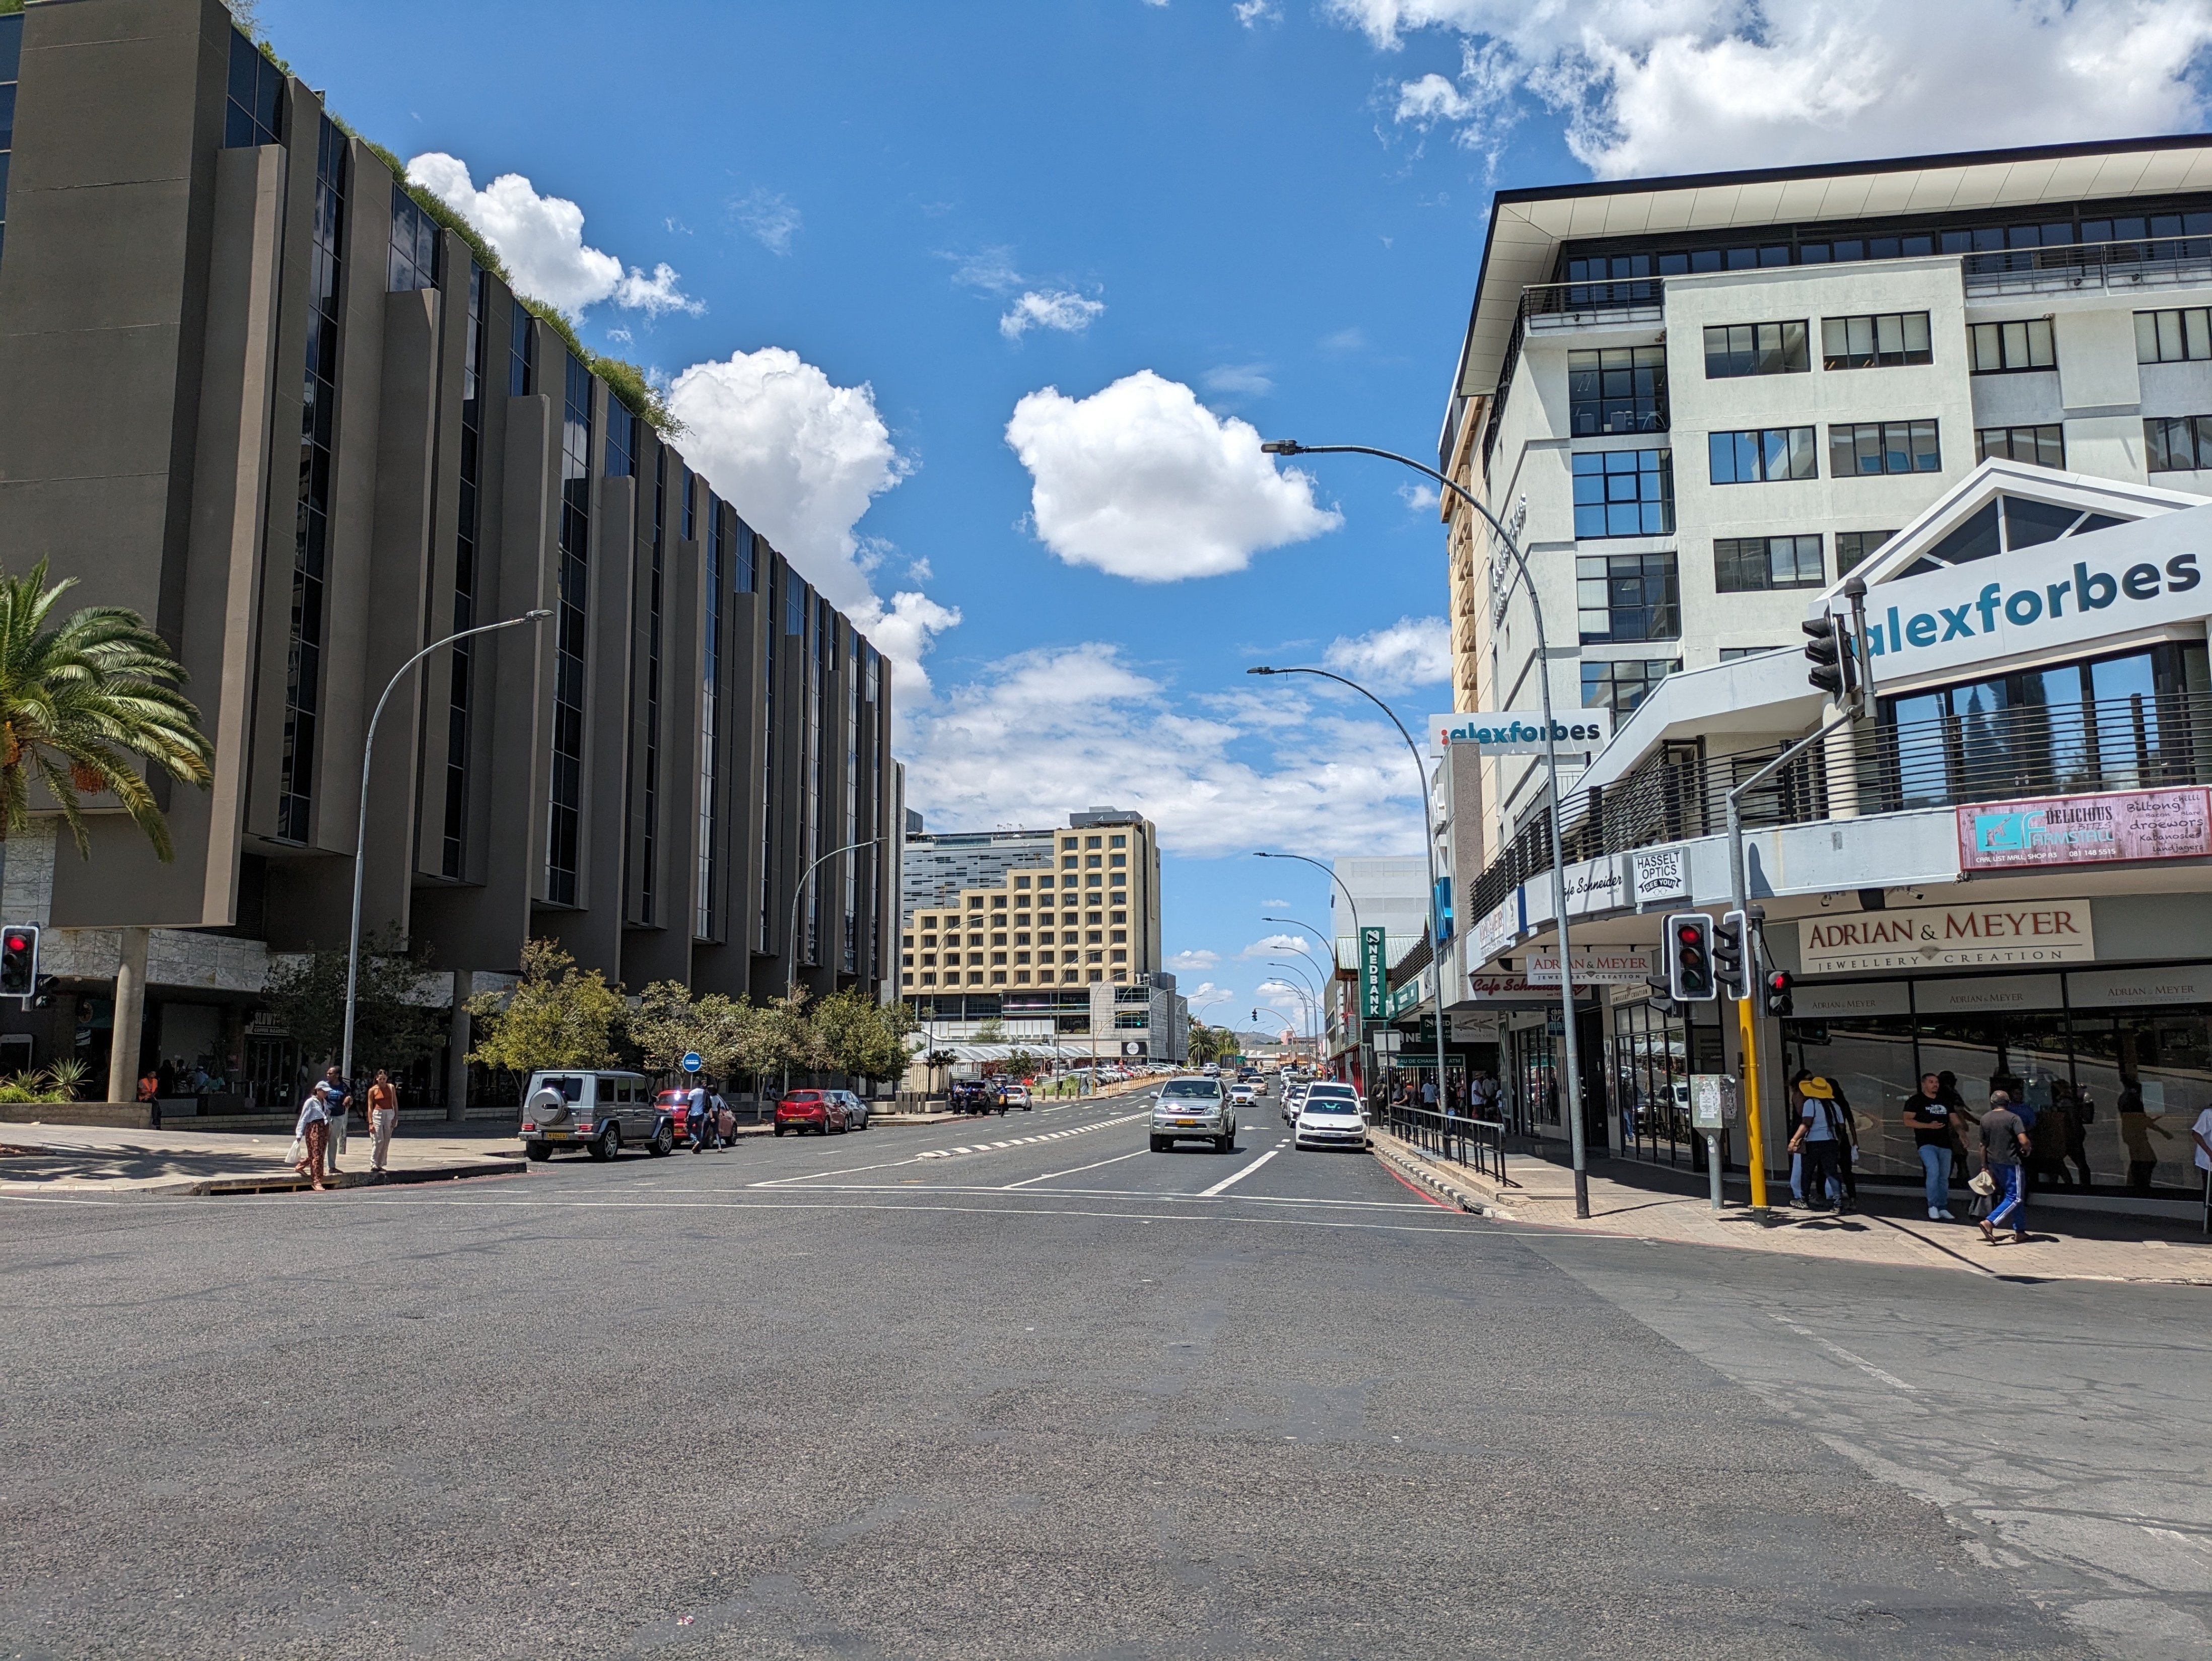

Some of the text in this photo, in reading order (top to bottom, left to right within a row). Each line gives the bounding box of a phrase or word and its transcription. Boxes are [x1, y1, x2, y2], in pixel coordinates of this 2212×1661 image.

[1851, 553, 2201, 658] alexforbes
[2127, 801, 2180, 812] Biltong
[2046, 806, 2113, 824] DELICIOUS
[2023, 811, 2115, 849] FARMSTALL
[2078, 821, 2111, 830] BITES
[2130, 819, 2203, 829] droewors
[2153, 844, 2203, 853] landjagers
[1638, 852, 1680, 869] HASSELT
[1642, 865, 1677, 879] OPTICS
[1577, 870, 1622, 894] Schneider
[1646, 880, 1675, 889] SEE YOU!
[1809, 911, 2081, 949] ADRIAN & MEYER
[1597, 957, 1649, 968] MEYER
[1818, 950, 2062, 972] JEWELLERY CREATION
[1368, 945, 1379, 1014] NEDBANK
[1472, 978, 1500, 996] Cafe
[2108, 988, 2146, 996] ADRIAN
[2155, 985, 2195, 994] MEYER
[1631, 989, 1648, 998] CREATION
[1950, 995, 1982, 1004] ADRIAN
[1990, 993, 2023, 1002] MEYER
[1846, 1000, 1876, 1008] MEYER
